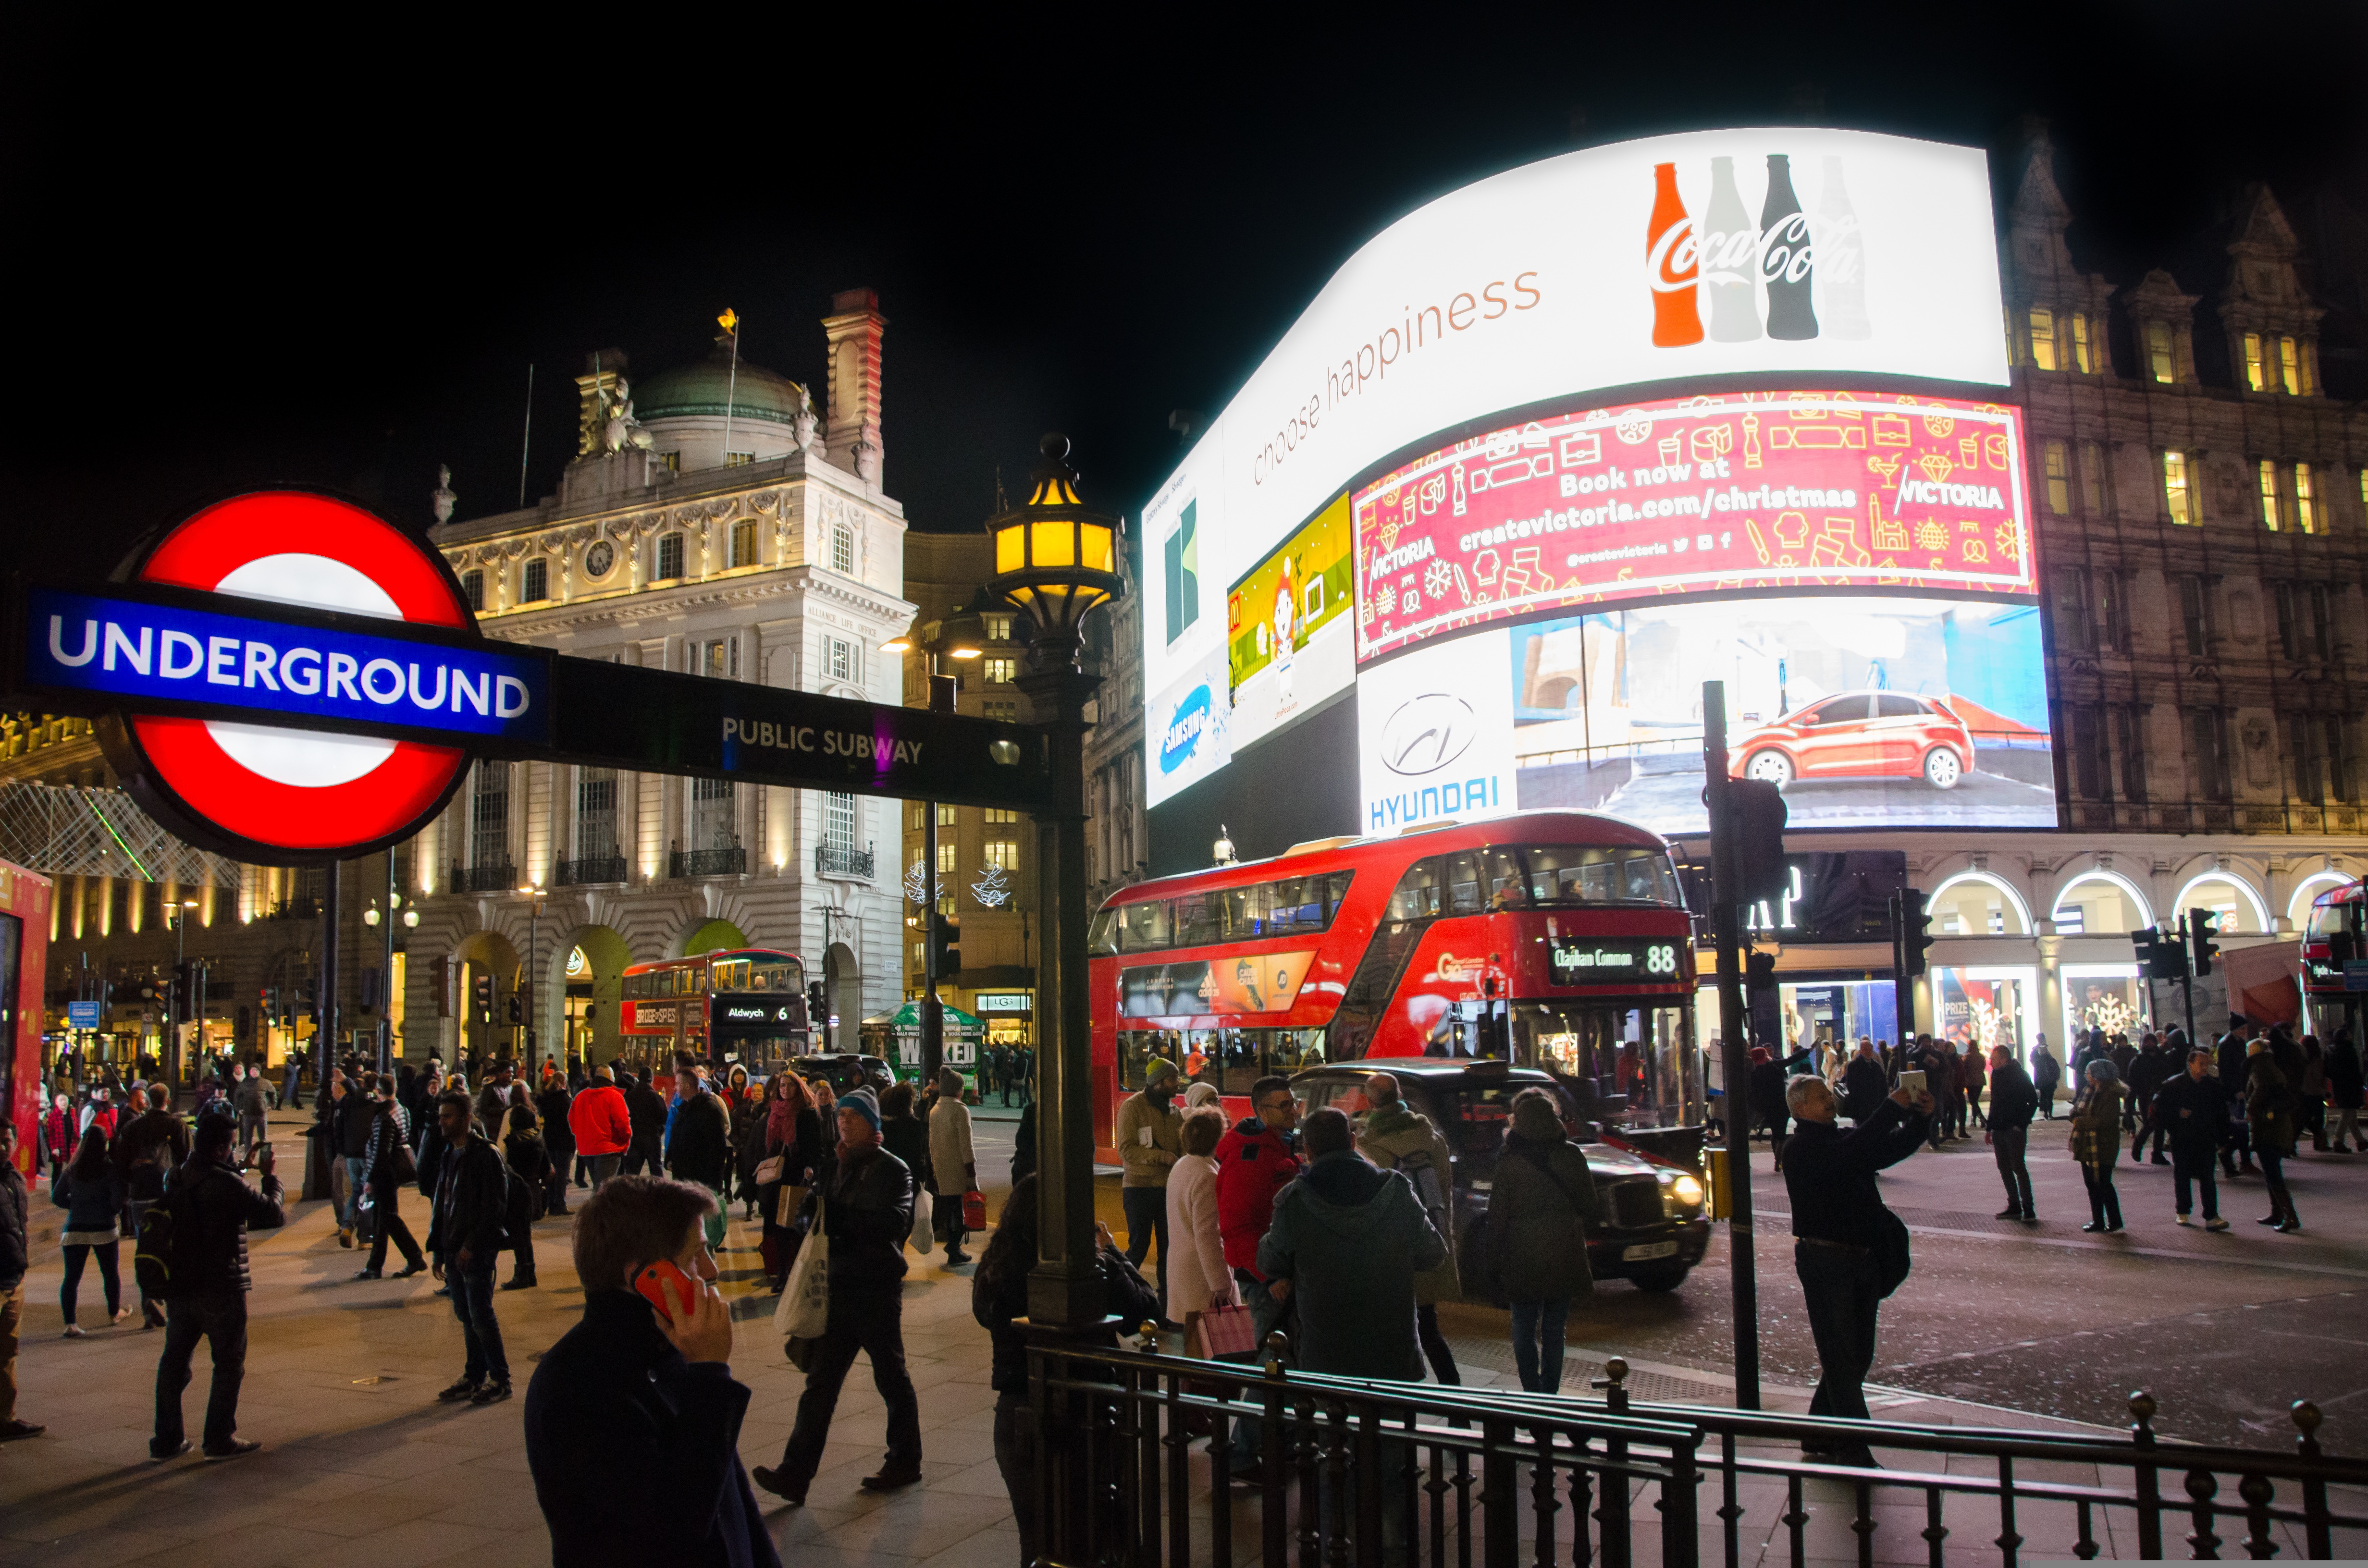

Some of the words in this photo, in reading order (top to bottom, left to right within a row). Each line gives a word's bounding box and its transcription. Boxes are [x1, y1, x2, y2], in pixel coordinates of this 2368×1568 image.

[1255, 393, 1320, 486] choose
[1327, 271, 1541, 412] happiness
[1560, 466, 1627, 498] Book
[1634, 462, 1693, 488] now
[1699, 456, 1731, 479] at
[1459, 485, 1857, 552] createvictoria.com/christmas
[808, 605, 837, 623] ALLIANCE
[841, 617, 853, 629] LIFE
[858, 624, 877, 637] OFFICE
[49, 614, 530, 719] UNDERGROUND
[722, 718, 814, 752] PUBLIC
[823, 730, 923, 765] SUBWAY
[1165, 705, 1206, 754] SAMSUNG
[1371, 776, 1498, 830] HYUNDAI
[1437, 951, 1462, 981] Go
[1554, 948, 1595, 972] Clapham
[1595, 949, 1633, 967] Common
[1647, 945, 1676, 973] 88
[994, 998, 1013, 1006] UGG
[1198, 987, 1220, 998] adidas
[728, 1008, 764, 1019] Aldwych
[778, 1007, 788, 1020] 6
[1944, 1002, 1969, 1016] PRIZE
